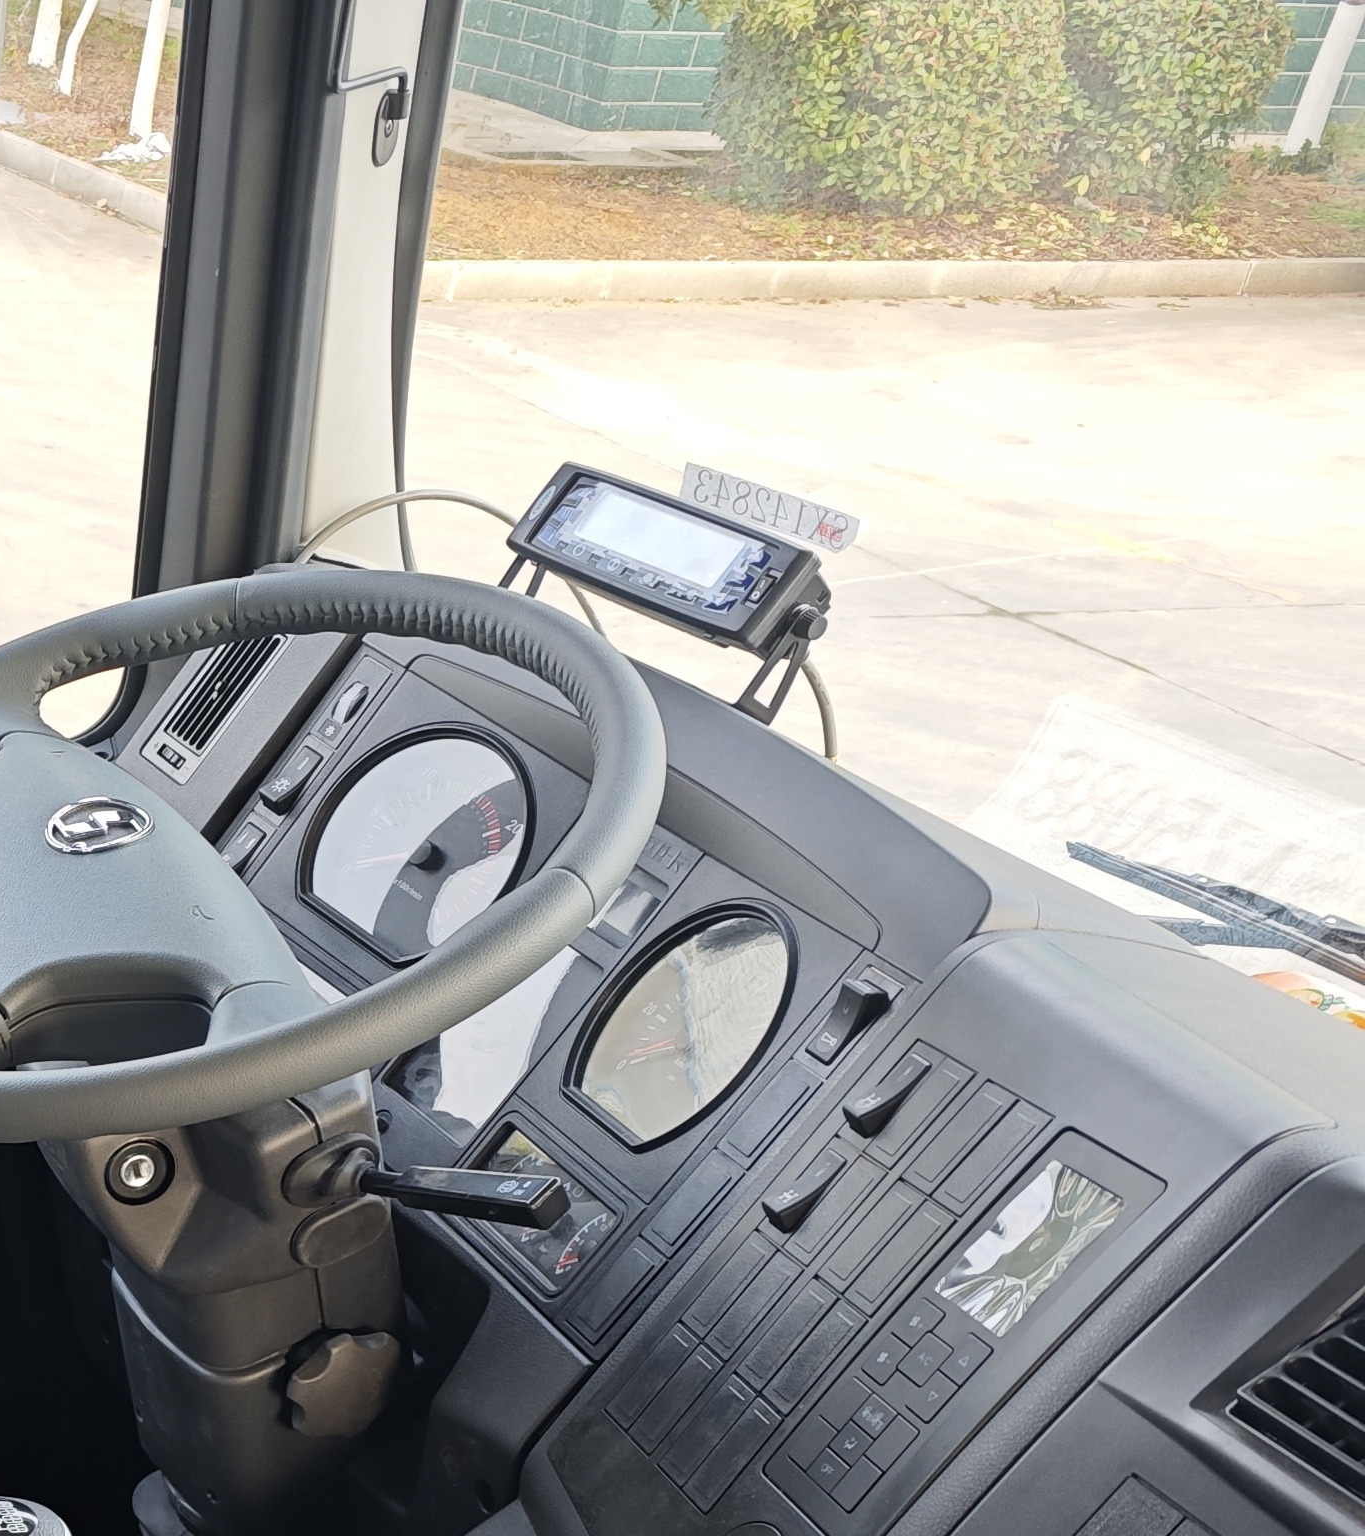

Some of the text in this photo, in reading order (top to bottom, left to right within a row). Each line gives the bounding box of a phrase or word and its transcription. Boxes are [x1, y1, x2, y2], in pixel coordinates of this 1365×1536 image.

[504, 818, 524, 835] 20
[641, 1002, 658, 1016] 20
[616, 1059, 627, 1071] 0
